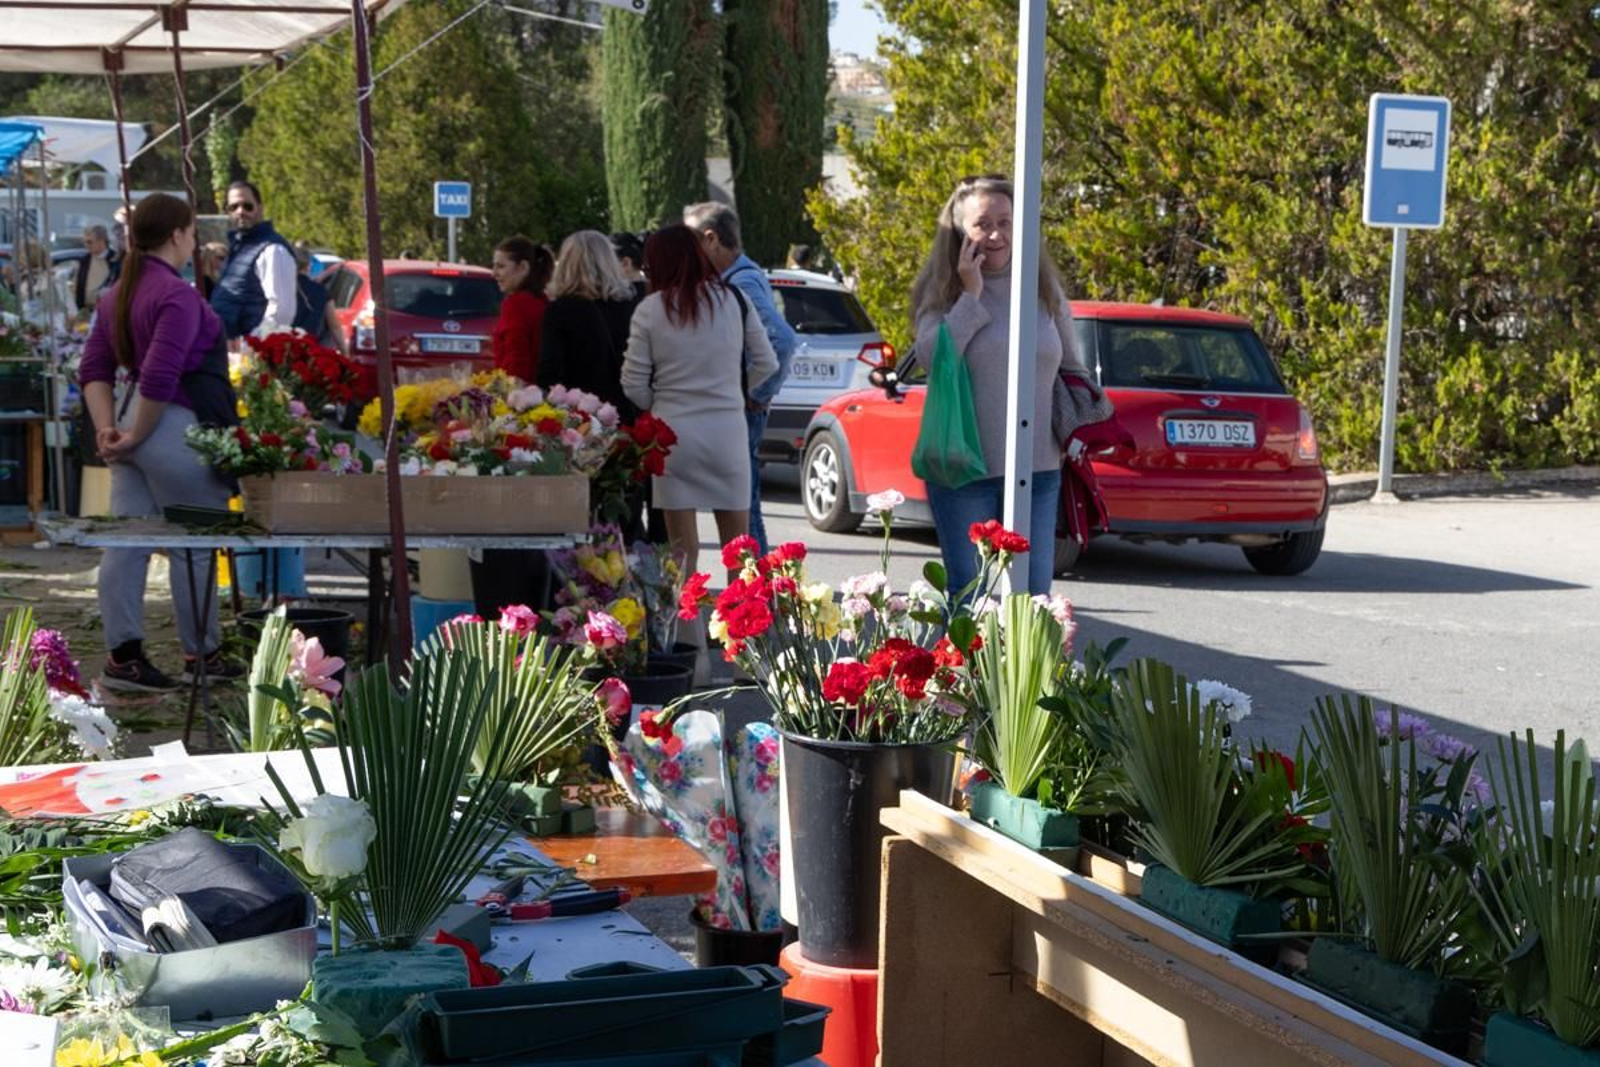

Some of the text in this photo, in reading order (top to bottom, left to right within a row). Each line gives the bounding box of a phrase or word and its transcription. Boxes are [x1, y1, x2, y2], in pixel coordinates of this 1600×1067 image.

[440, 193, 470, 205] TAXI
[1179, 423, 1249, 441] 1370 DSZ
